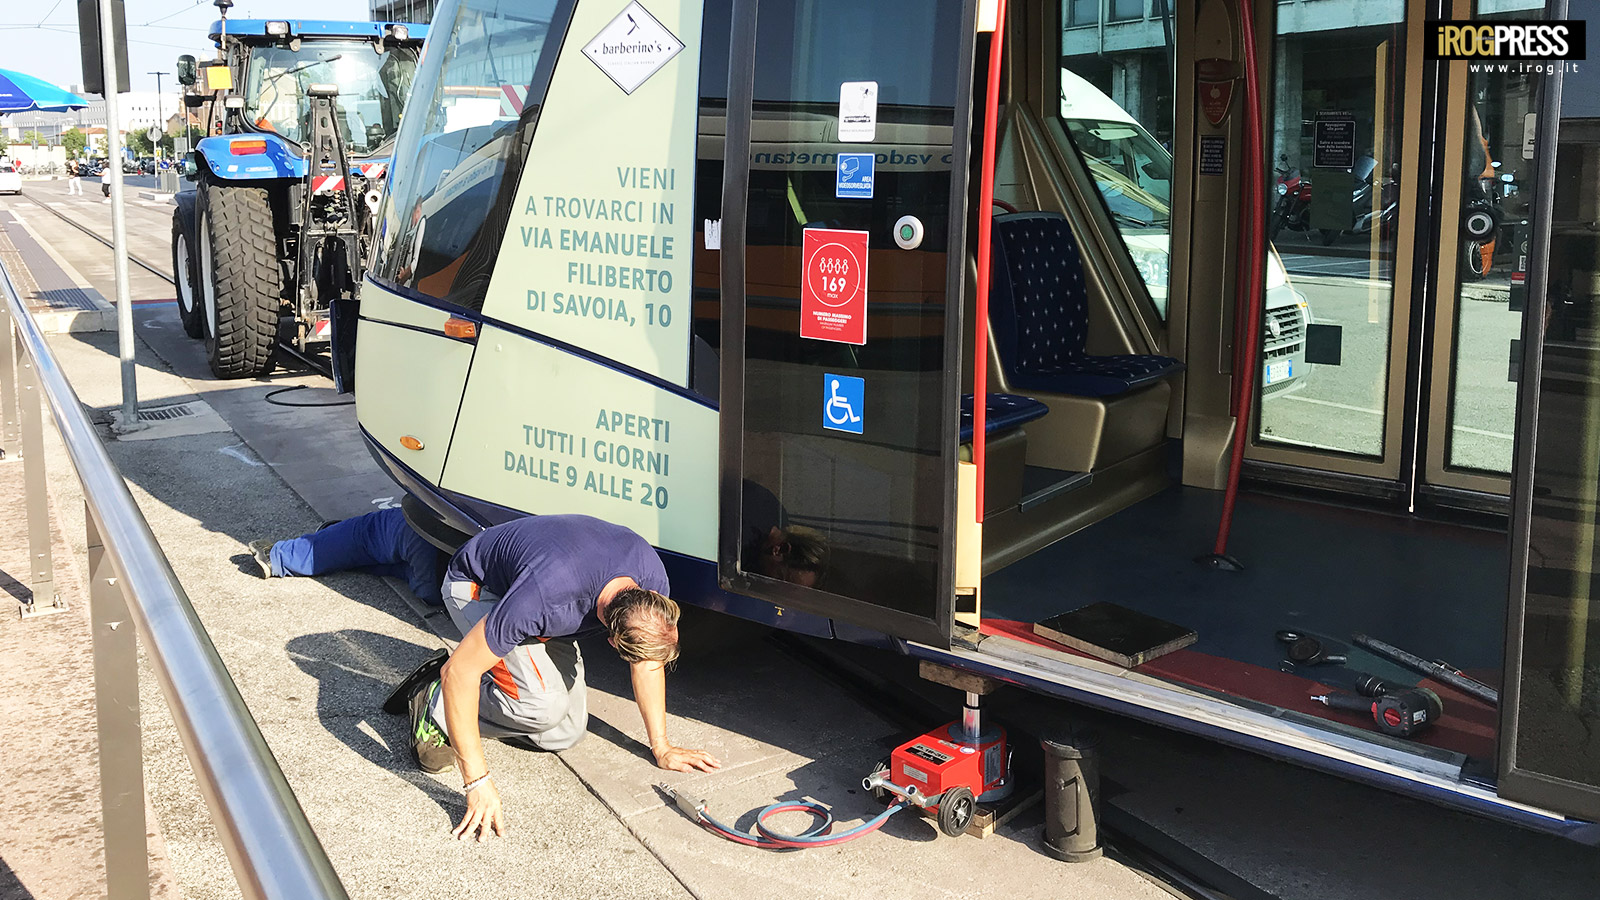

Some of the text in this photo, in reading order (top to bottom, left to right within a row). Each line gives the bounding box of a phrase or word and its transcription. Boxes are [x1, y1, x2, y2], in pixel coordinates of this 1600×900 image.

[602, 40, 662, 55] barberino's
[617, 166, 675, 190] VIENI
[525, 196, 674, 224] A TROVARCI IN
[520, 226, 674, 260] VIA EMANUELE
[568, 262, 673, 294] FILIBERTO
[822, 276, 846, 293] 169
[526, 290, 672, 328] DI SAVOIA, 10
[596, 408, 670, 443] APERTI
[523, 424, 669, 476] TUTTI I GIORNI
[504, 450, 668, 510] DALLE 9 ALLE 20
